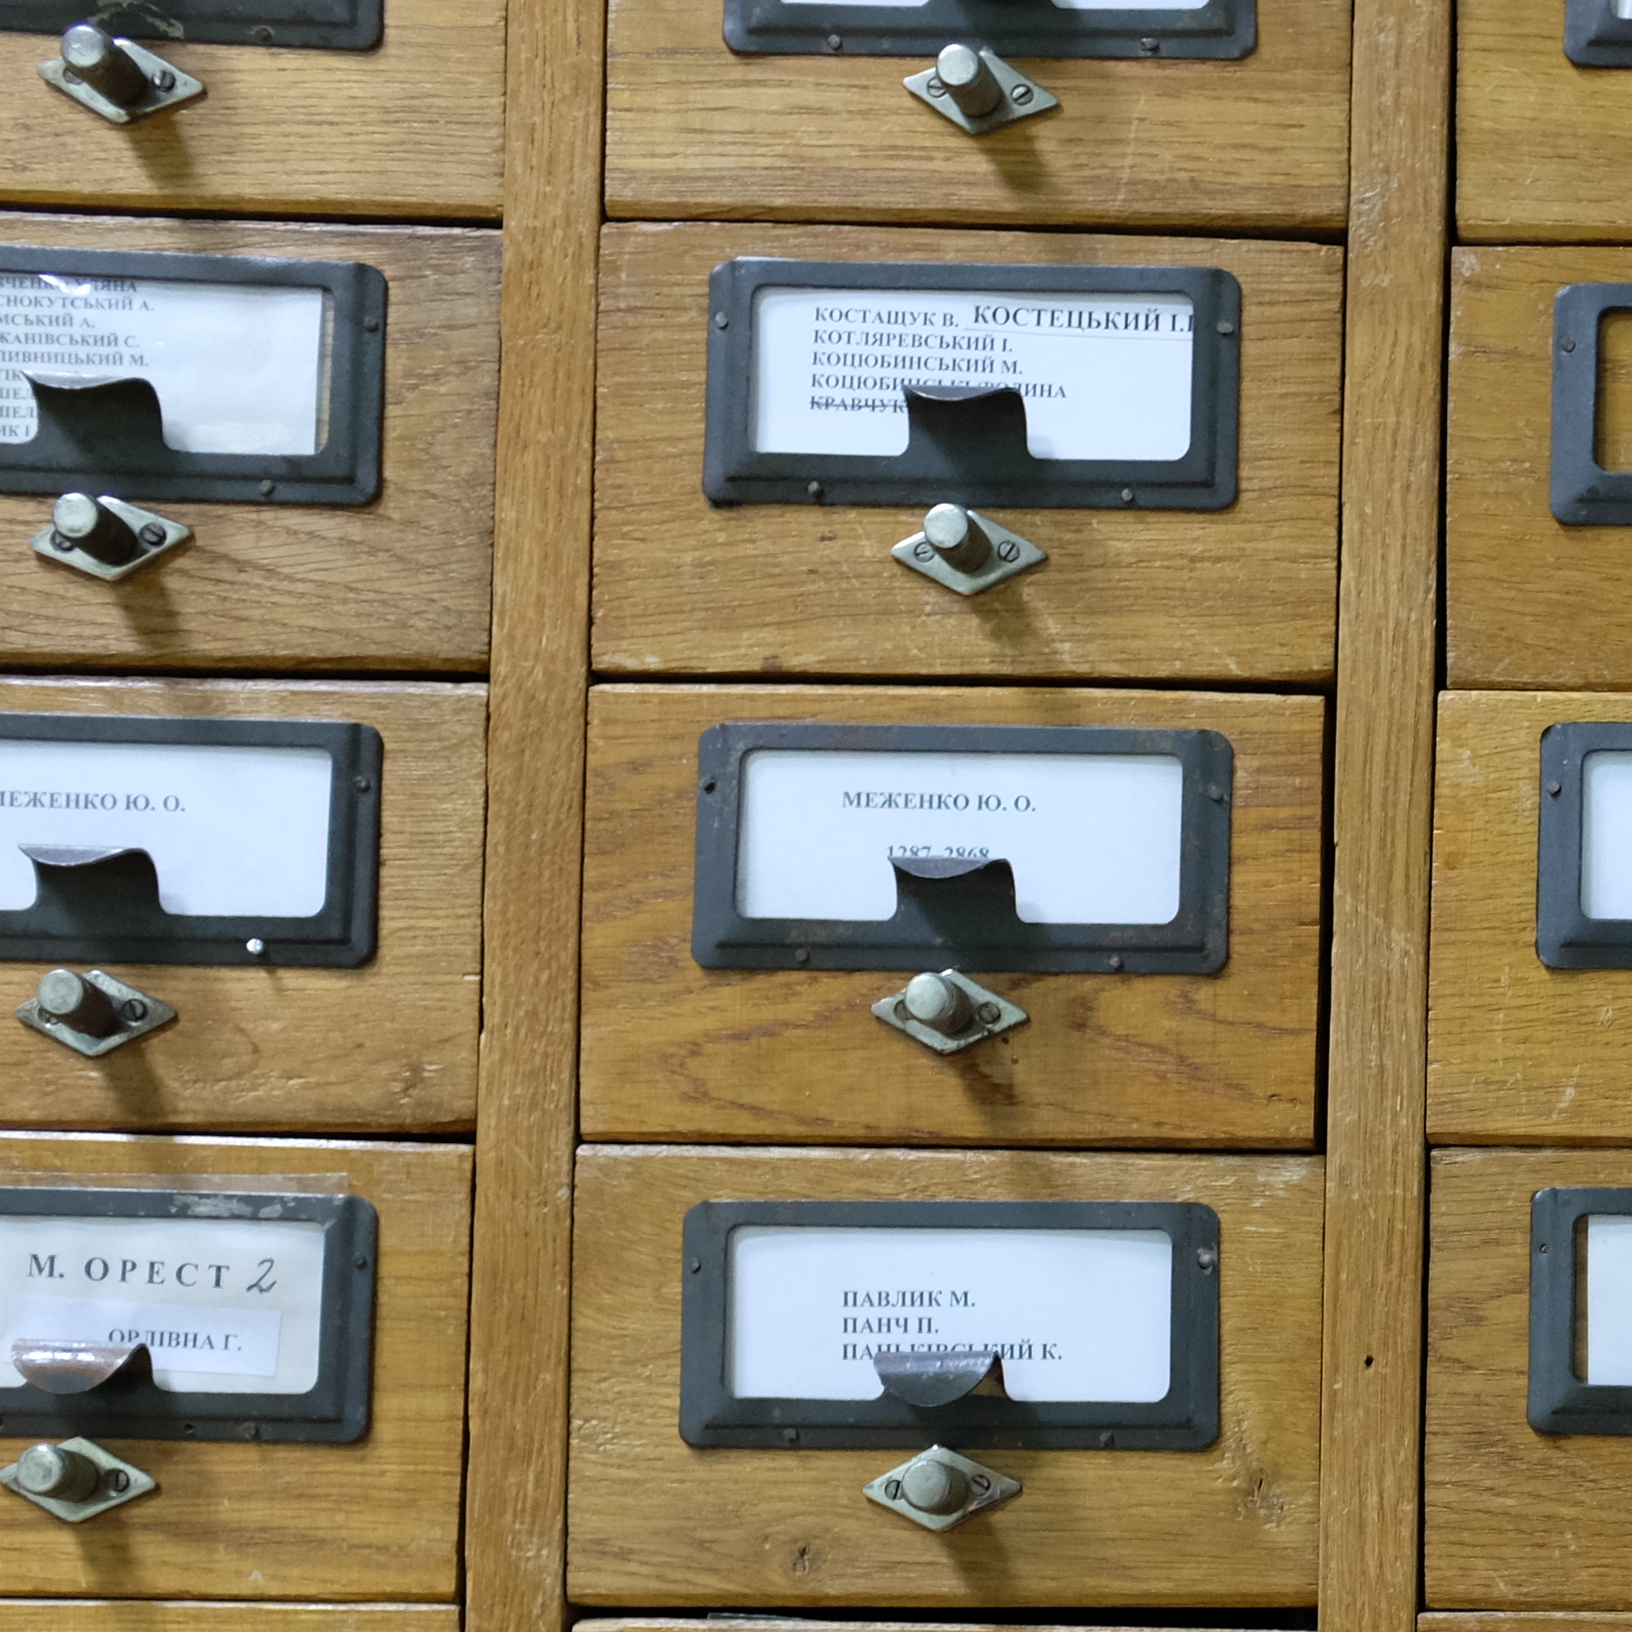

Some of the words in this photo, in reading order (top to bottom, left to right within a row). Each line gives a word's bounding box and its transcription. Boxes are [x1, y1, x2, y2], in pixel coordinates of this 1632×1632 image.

[140, 299, 155, 312] А.
[78, 317, 96, 329] А.
[815, 306, 937, 327] КОСТАЩУК
[942, 312, 959, 328] В.
[973, 305, 1161, 332] КОСТЕЦЬКИЙ
[123, 334, 141, 349] С.
[813, 329, 995, 352] КОТЛЯРЕВСЬКИЙ
[1001, 337, 1013, 353] І.
[129, 353, 149, 367] М.
[812, 351, 995, 374] КОЦЮБИНСЬКИЙ
[1002, 359, 1023, 375] М.
[124, 794, 156, 812] Ю.
[162, 795, 186, 813] О.
[843, 791, 970, 811] МЕЖЕНКО
[977, 794, 1007, 812] Ю.
[1013, 795, 1036, 812] О.
[28, 1253, 65, 1279] М.
[84, 1256, 230, 1289] ОРЕСТ
[246, 1257, 278, 1293] 2
[843, 1290, 943, 1308] ПАВЛИК
[949, 1290, 976, 1308] М.
[842, 1317, 909, 1334] ПАНЧ
[917, 1317, 939, 1334] П.
[223, 1333, 242, 1352] Г.
[1041, 1343, 1063, 1361] К.
